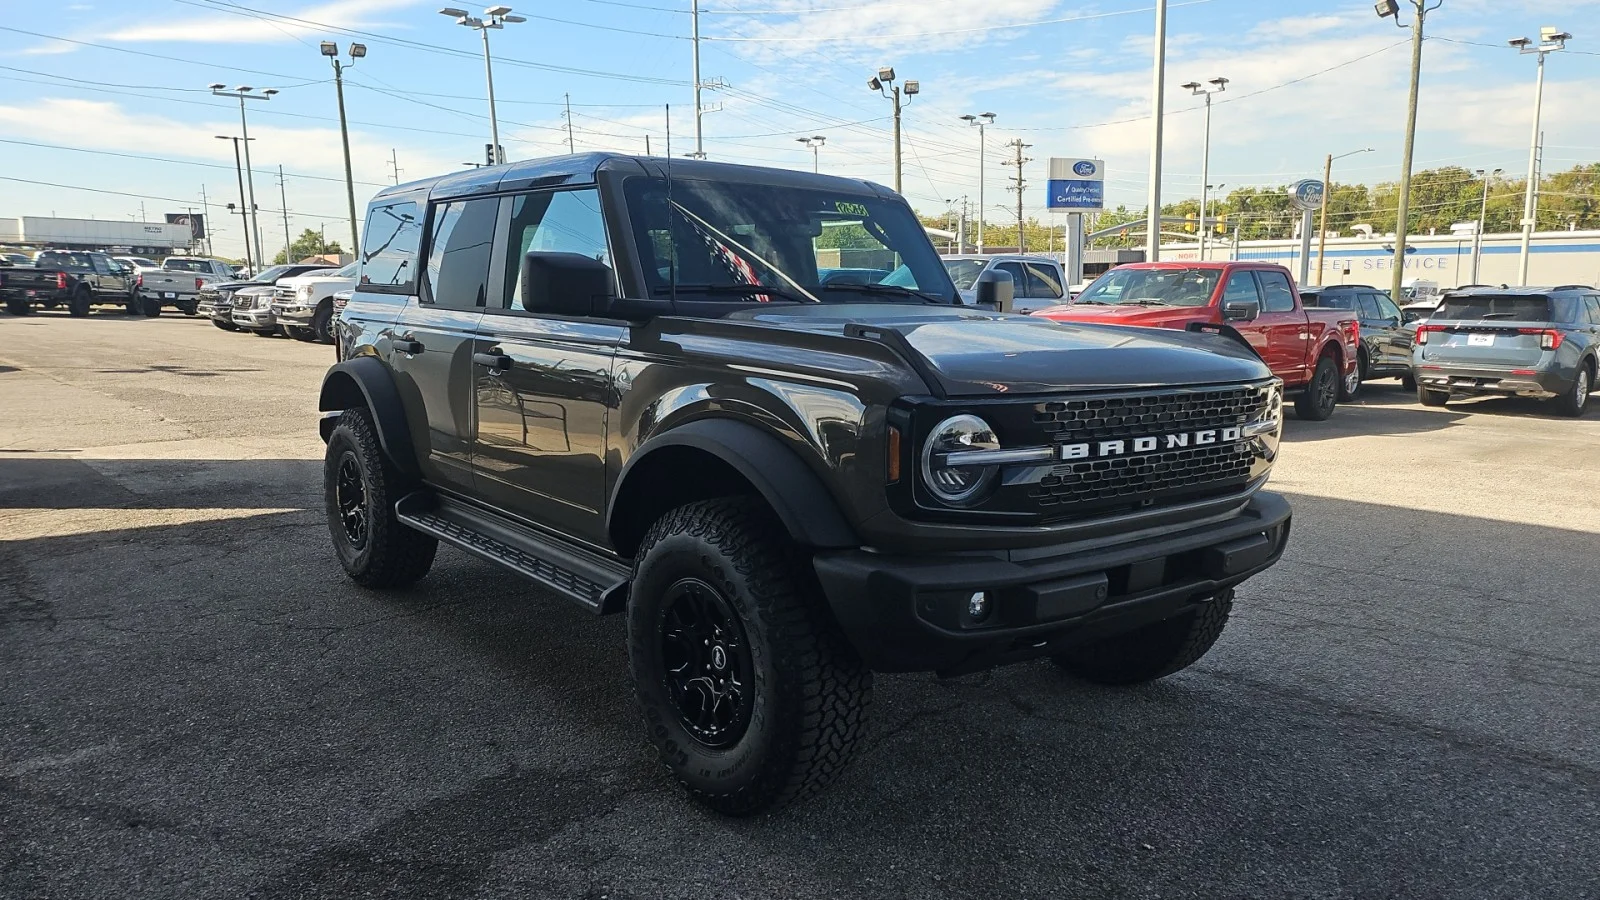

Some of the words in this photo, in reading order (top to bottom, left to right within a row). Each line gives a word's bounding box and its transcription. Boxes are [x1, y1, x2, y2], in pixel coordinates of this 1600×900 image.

[1057, 195, 1081, 203] Certified
[1309, 259, 1353, 271] LEET
[1060, 427, 1241, 460] BRONCO
